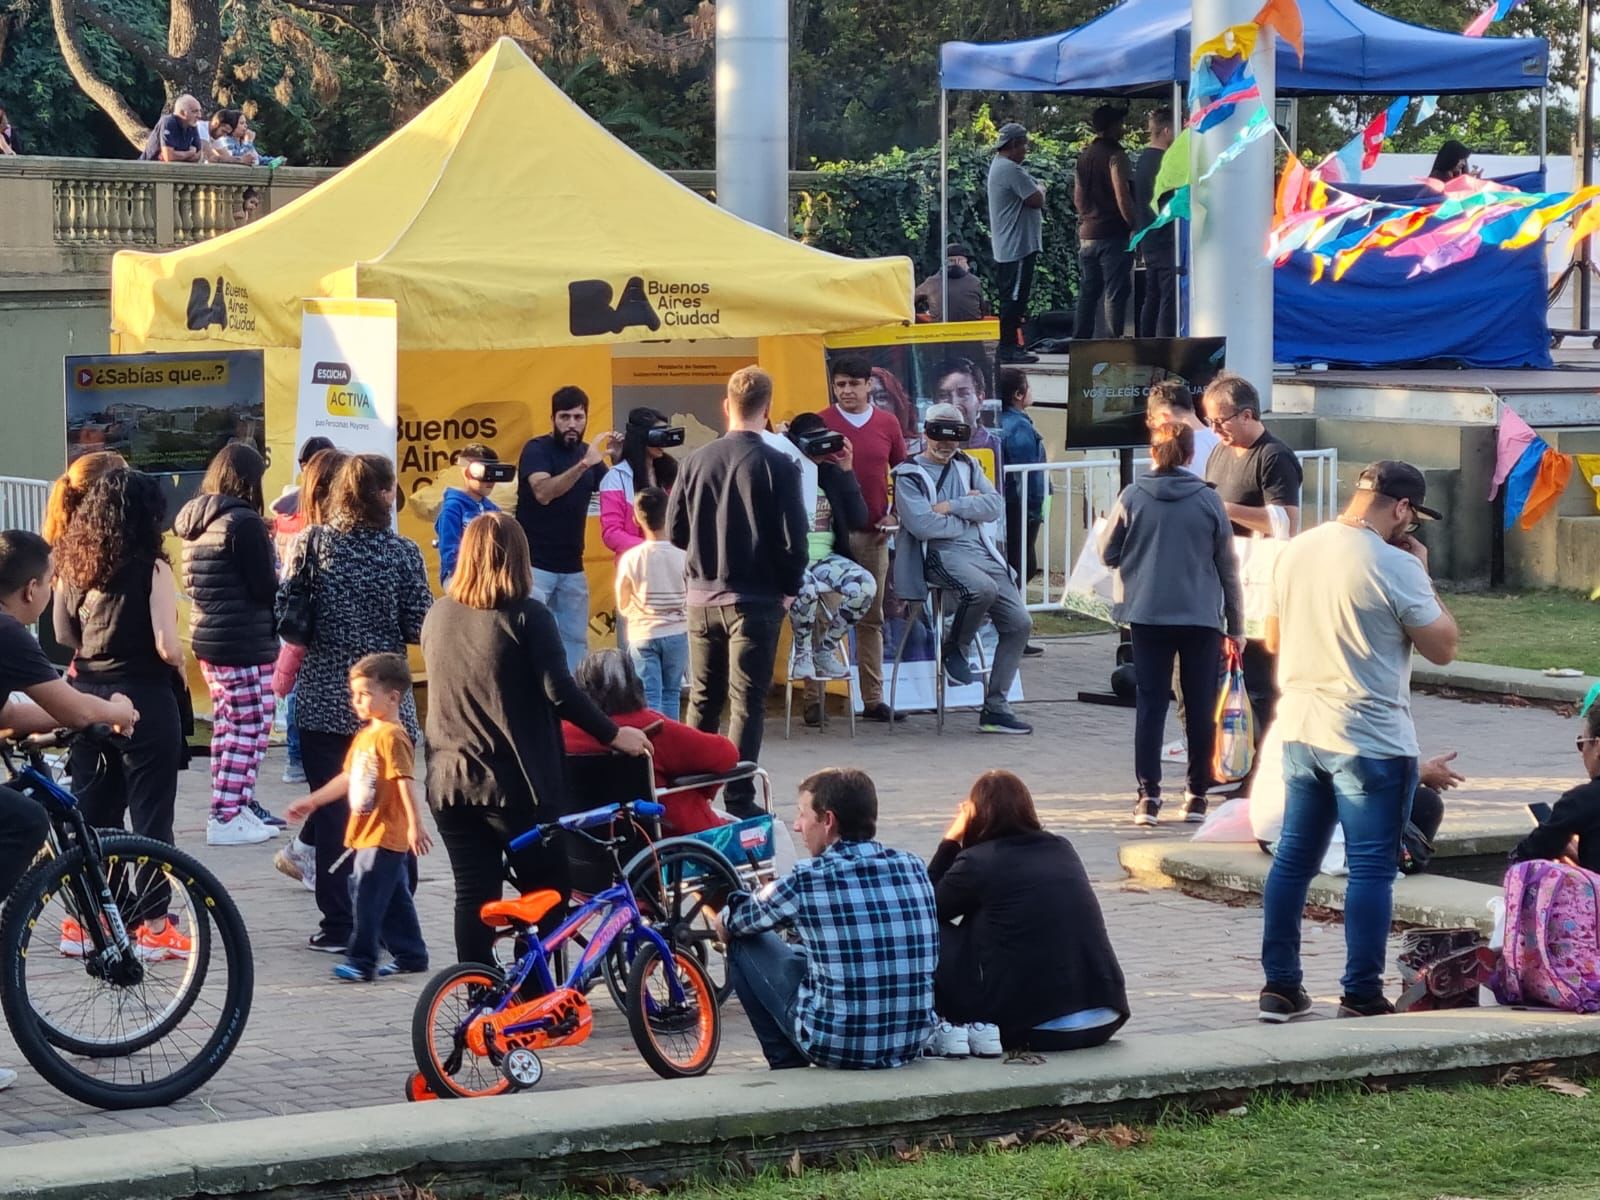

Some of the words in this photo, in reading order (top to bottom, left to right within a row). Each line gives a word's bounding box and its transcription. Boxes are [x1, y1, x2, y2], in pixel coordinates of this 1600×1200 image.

[648, 281, 710, 295] Buenos
[228, 299, 249, 314] Aires
[658, 296, 702, 310] Aires
[229, 314, 256, 331] Ciudad
[664, 309, 720, 326] Ciudad
[95, 366, 164, 385] ¿Sabías
[317, 368, 347, 380] ESCUCHA
[330, 391, 370, 408] ACTIVA
